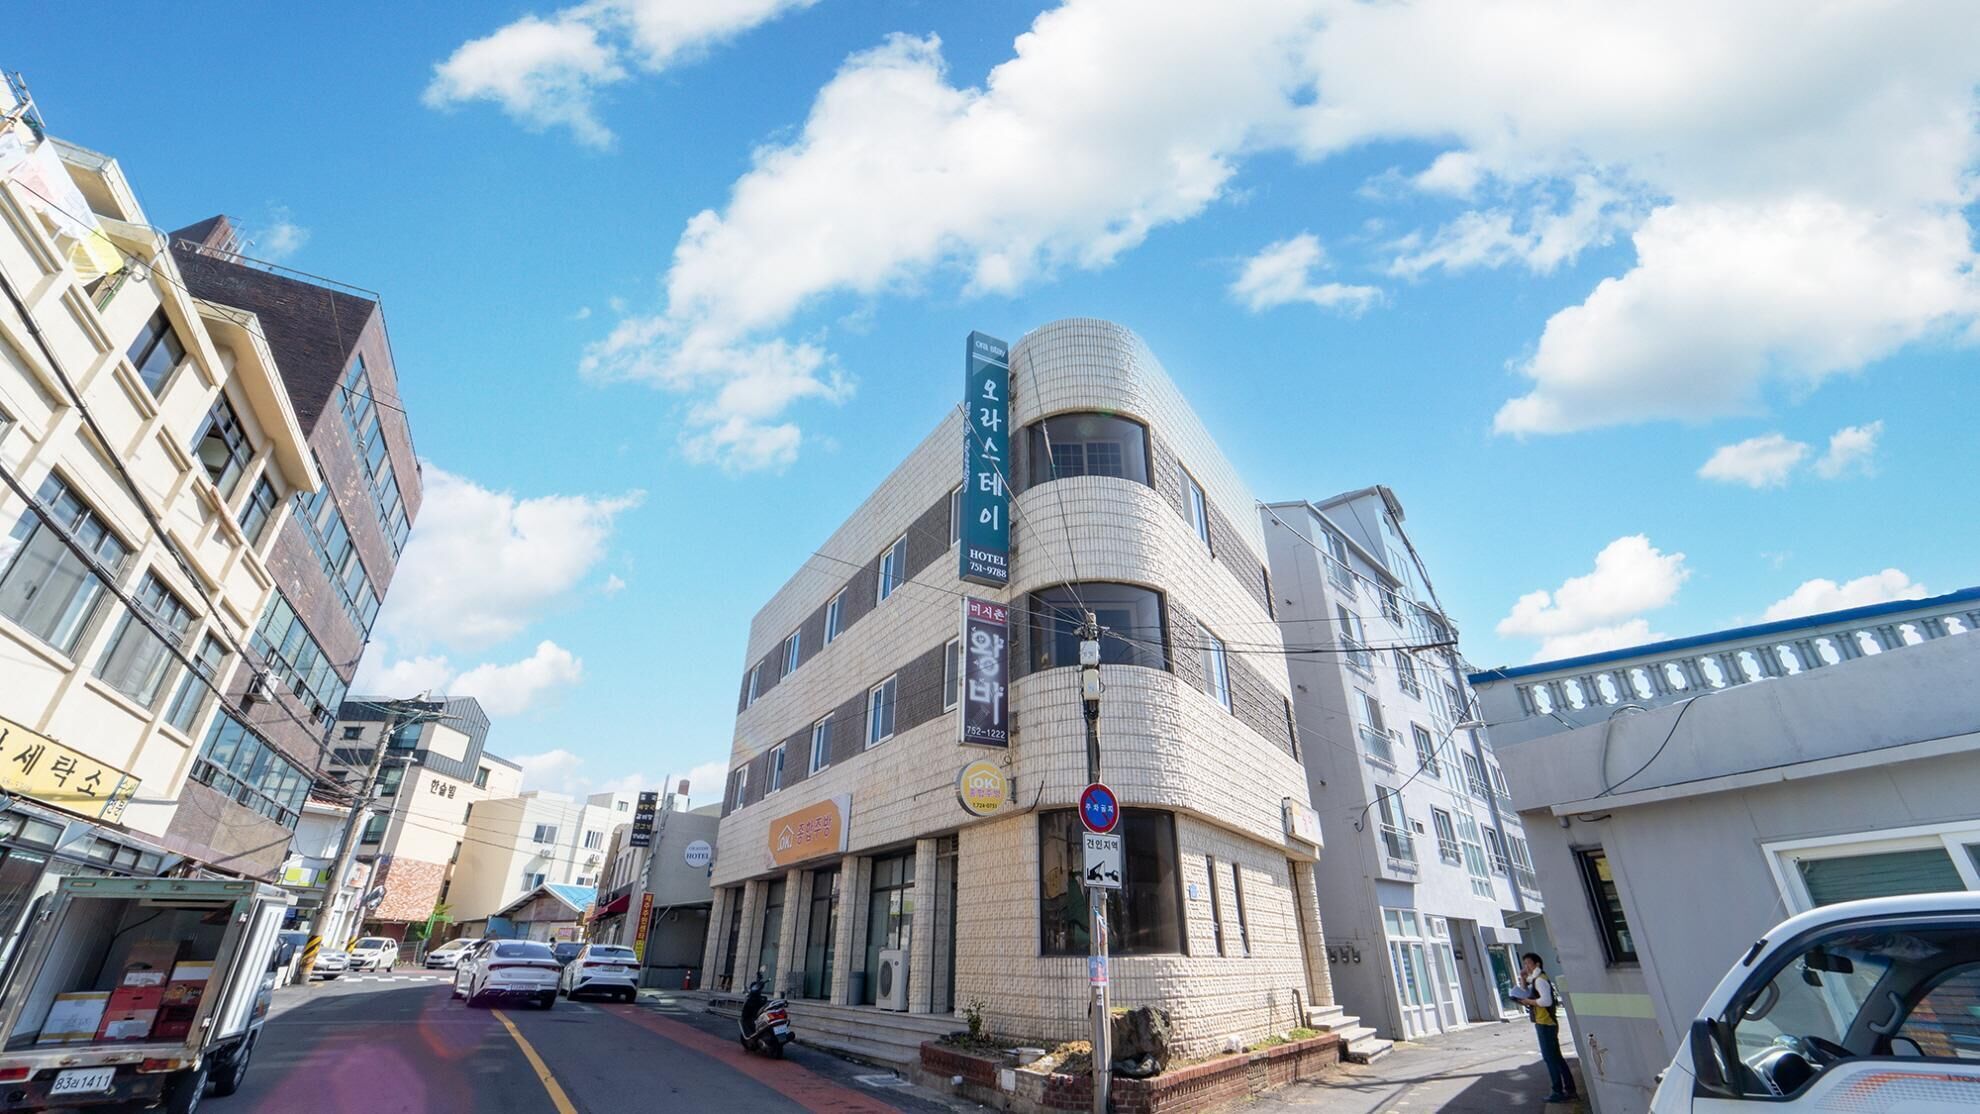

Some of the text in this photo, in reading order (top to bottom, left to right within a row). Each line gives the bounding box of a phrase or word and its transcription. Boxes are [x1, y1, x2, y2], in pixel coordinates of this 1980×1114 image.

[978, 379, 1002, 531] 오라스테이
[969, 548, 1007, 567] HOTEL
[969, 561, 1007, 578] 751-9788
[969, 629, 1005, 726] 왕바
[974, 777, 994, 789] OK
[1085, 802, 1114, 814] 주차금지
[796, 814, 832, 845] 종합주방
[1086, 838, 1118, 851] 견인지역
[686, 852, 709, 860] HOTEL
